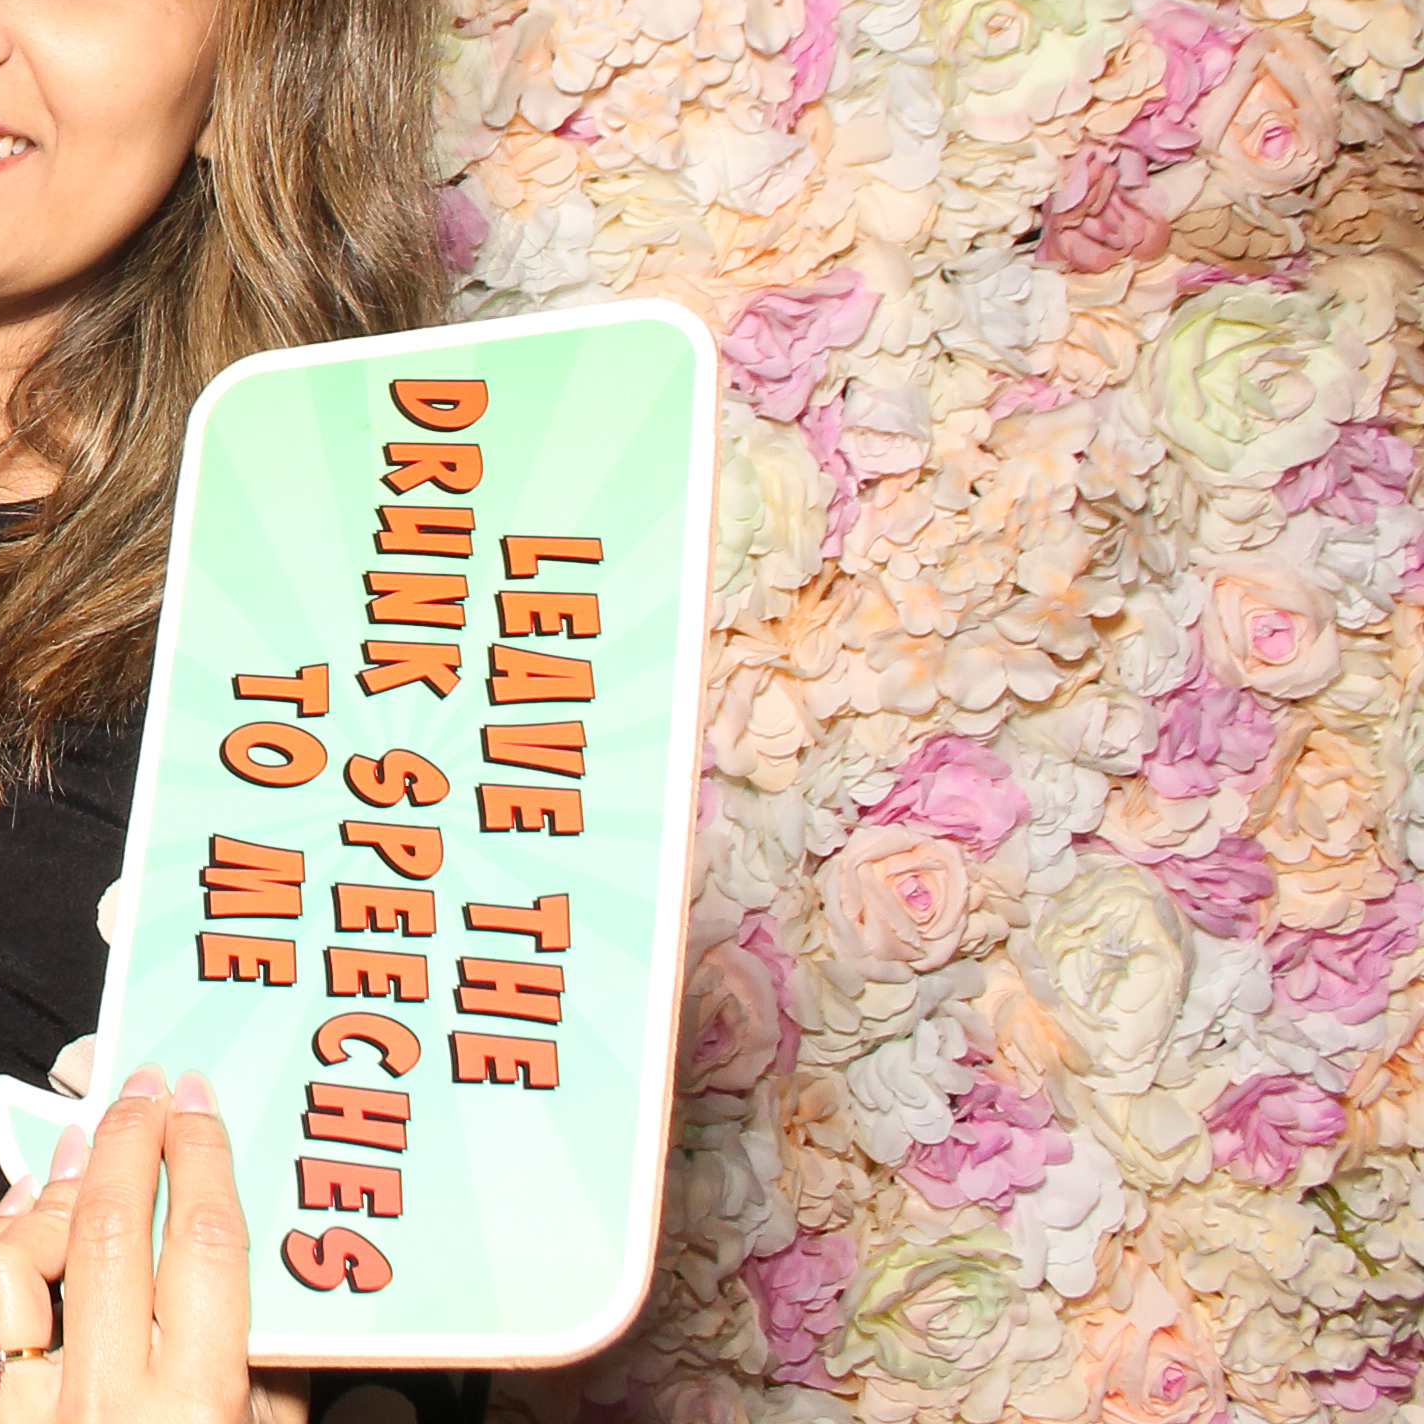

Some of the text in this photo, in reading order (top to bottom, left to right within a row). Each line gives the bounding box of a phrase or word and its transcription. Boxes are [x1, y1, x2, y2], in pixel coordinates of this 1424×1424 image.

[196, 662, 329, 987] TO ME
[282, 378, 488, 1294] DRUNK SPEECHES
[449, 535, 604, 1090] LEAVE THE
